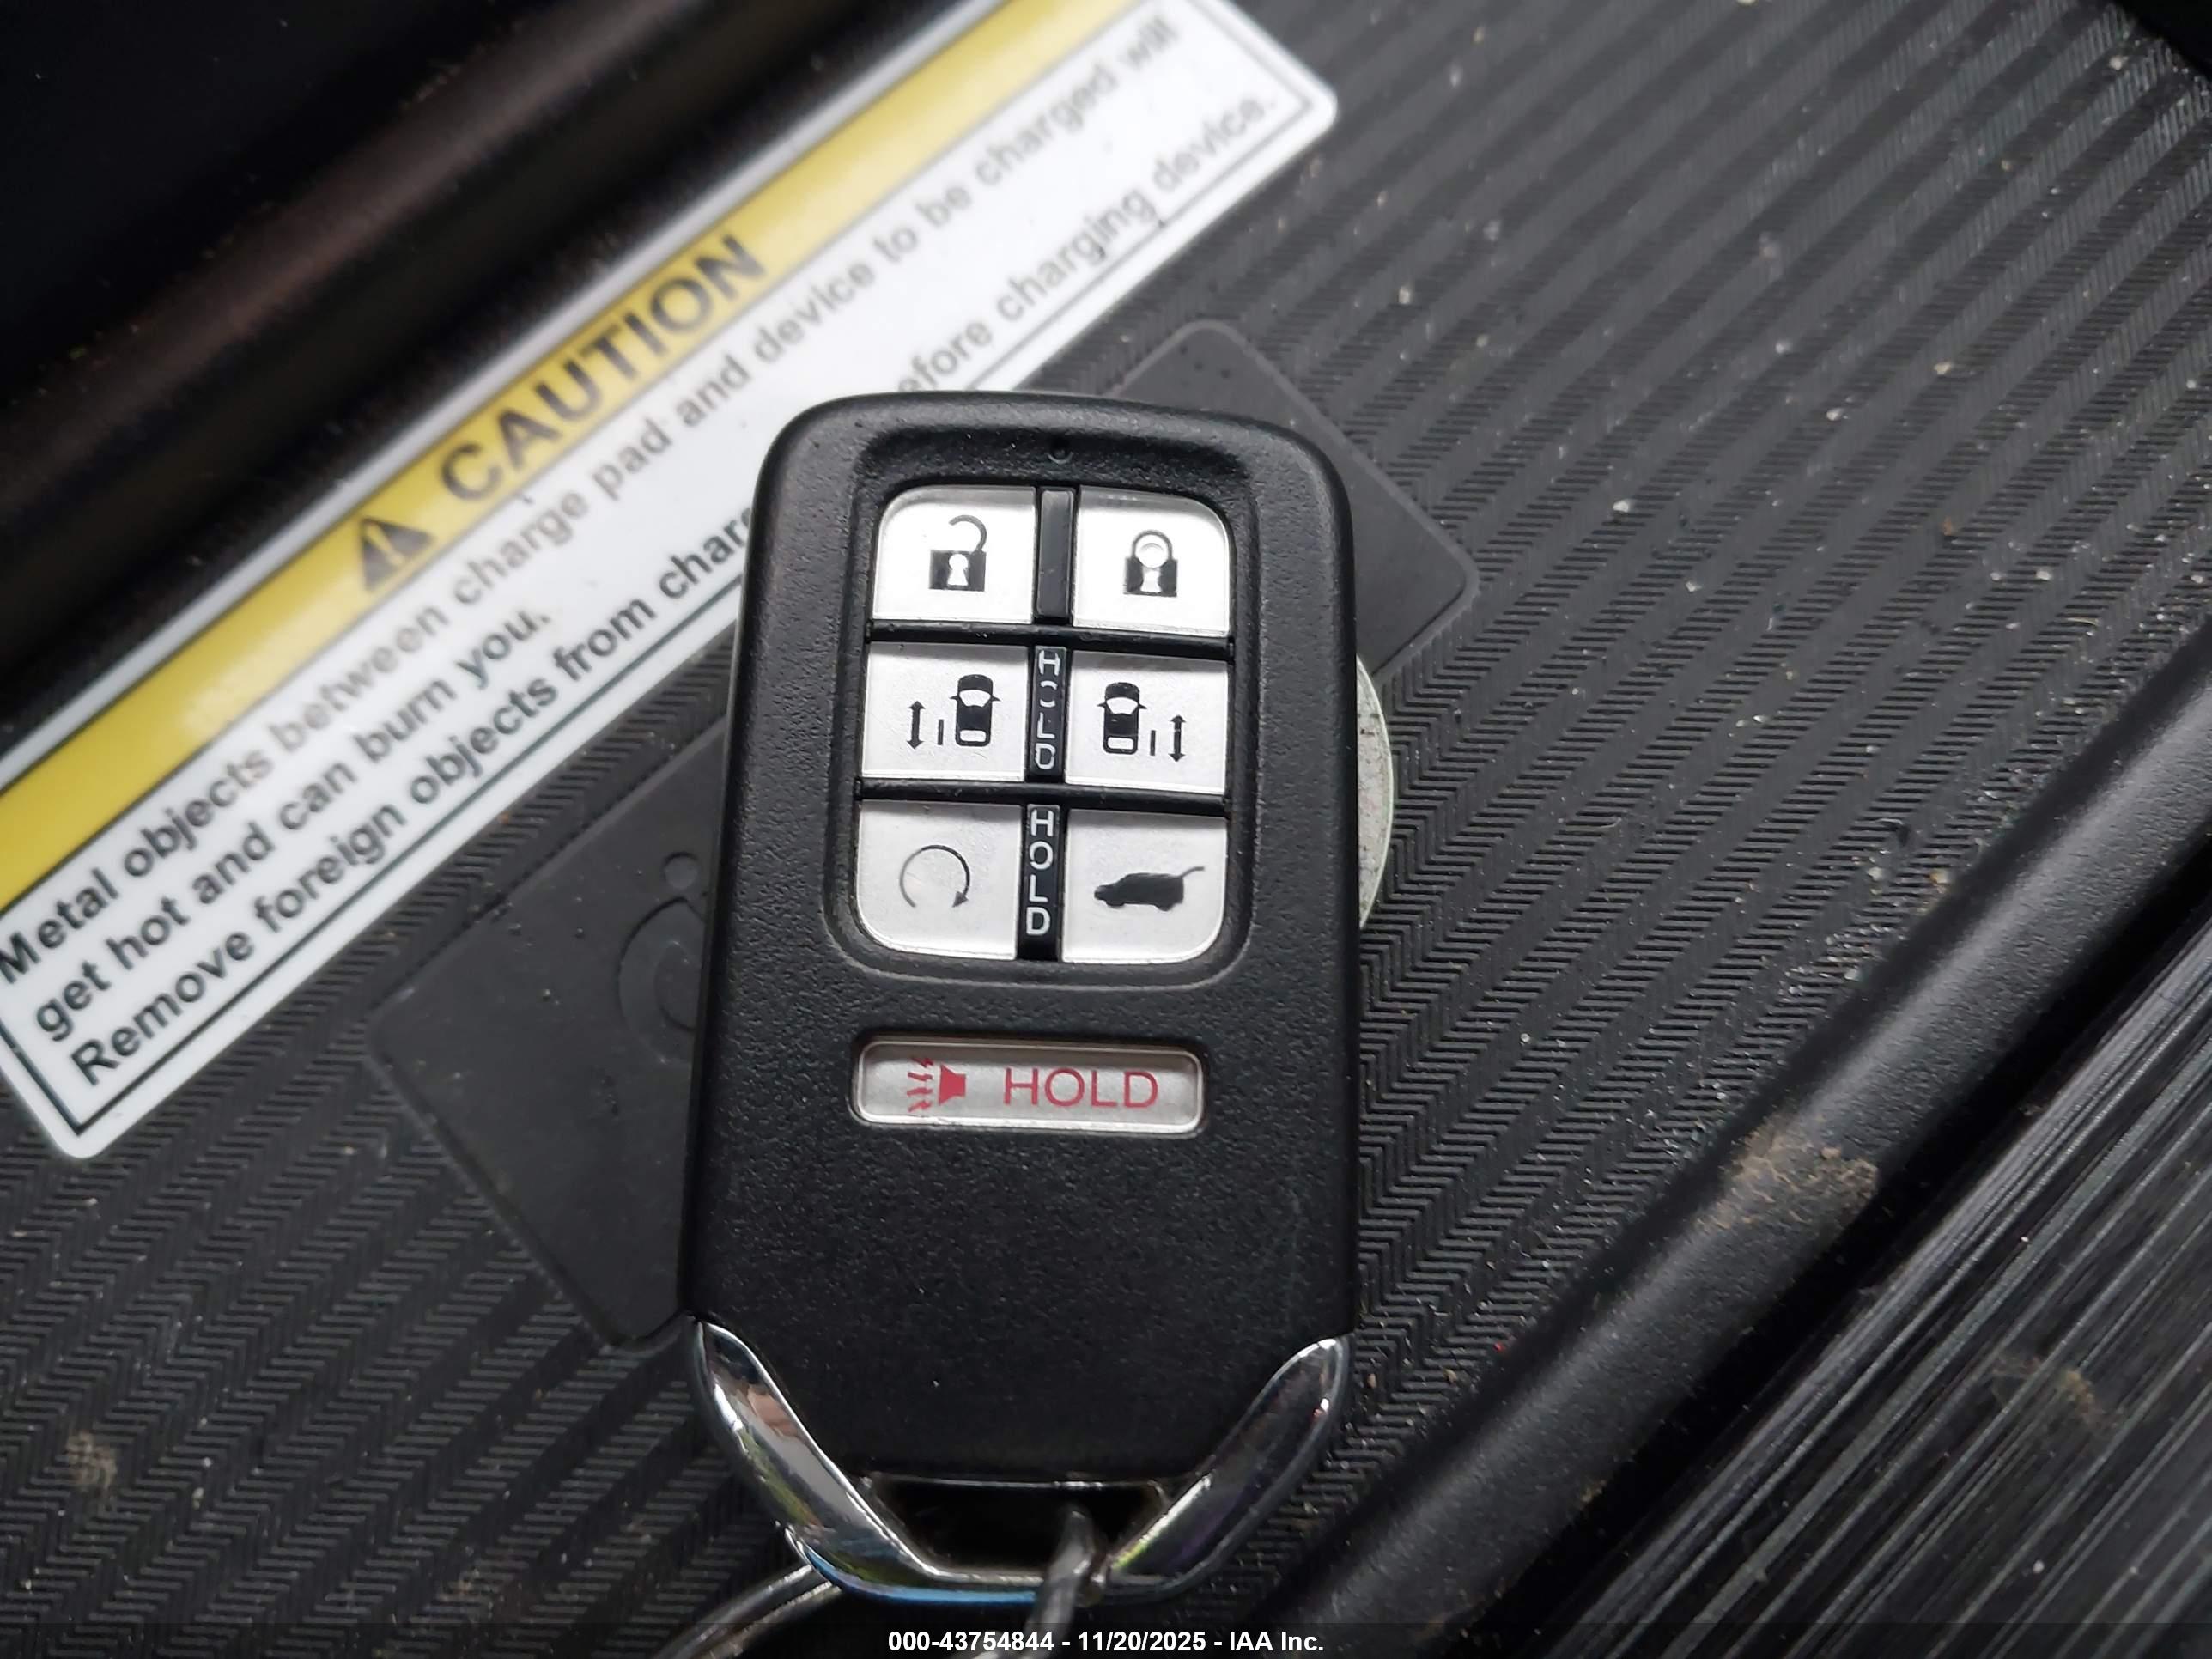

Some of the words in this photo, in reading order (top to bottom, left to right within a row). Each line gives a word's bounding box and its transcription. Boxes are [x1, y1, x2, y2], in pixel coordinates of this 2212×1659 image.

[0, 867, 118, 983] Metal
[124, 747, 270, 877] objects
[269, 605, 449, 752] between
[454, 492, 588, 606] charge
[593, 420, 672, 501] pad
[678, 355, 752, 428] and
[755, 263, 876, 362] device
[874, 228, 919, 264] to
[916, 182, 972, 228] be
[975, 63, 1119, 185] charged
[1122, 14, 1179, 70] will
[441, 234, 769, 502] CAUTION
[70, 931, 255, 1086] Remove
[253, 805, 404, 933] foreign
[412, 678, 557, 804] objects
[554, 598, 656, 683] from
[659, 507, 752, 599] char
[997, 191, 1158, 322] charging
[1153, 96, 1278, 191] device.
[1035, 648, 1060, 770] HOLD
[36, 960, 112, 1042] get
[105, 896, 191, 971] hot
[192, 821, 276, 904] and
[277, 758, 356, 833] can
[355, 676, 456, 765] burn
[458, 611, 550, 689] you.
[1025, 809, 1054, 936] HOLD
[1003, 1067, 1158, 1109] HOLD
